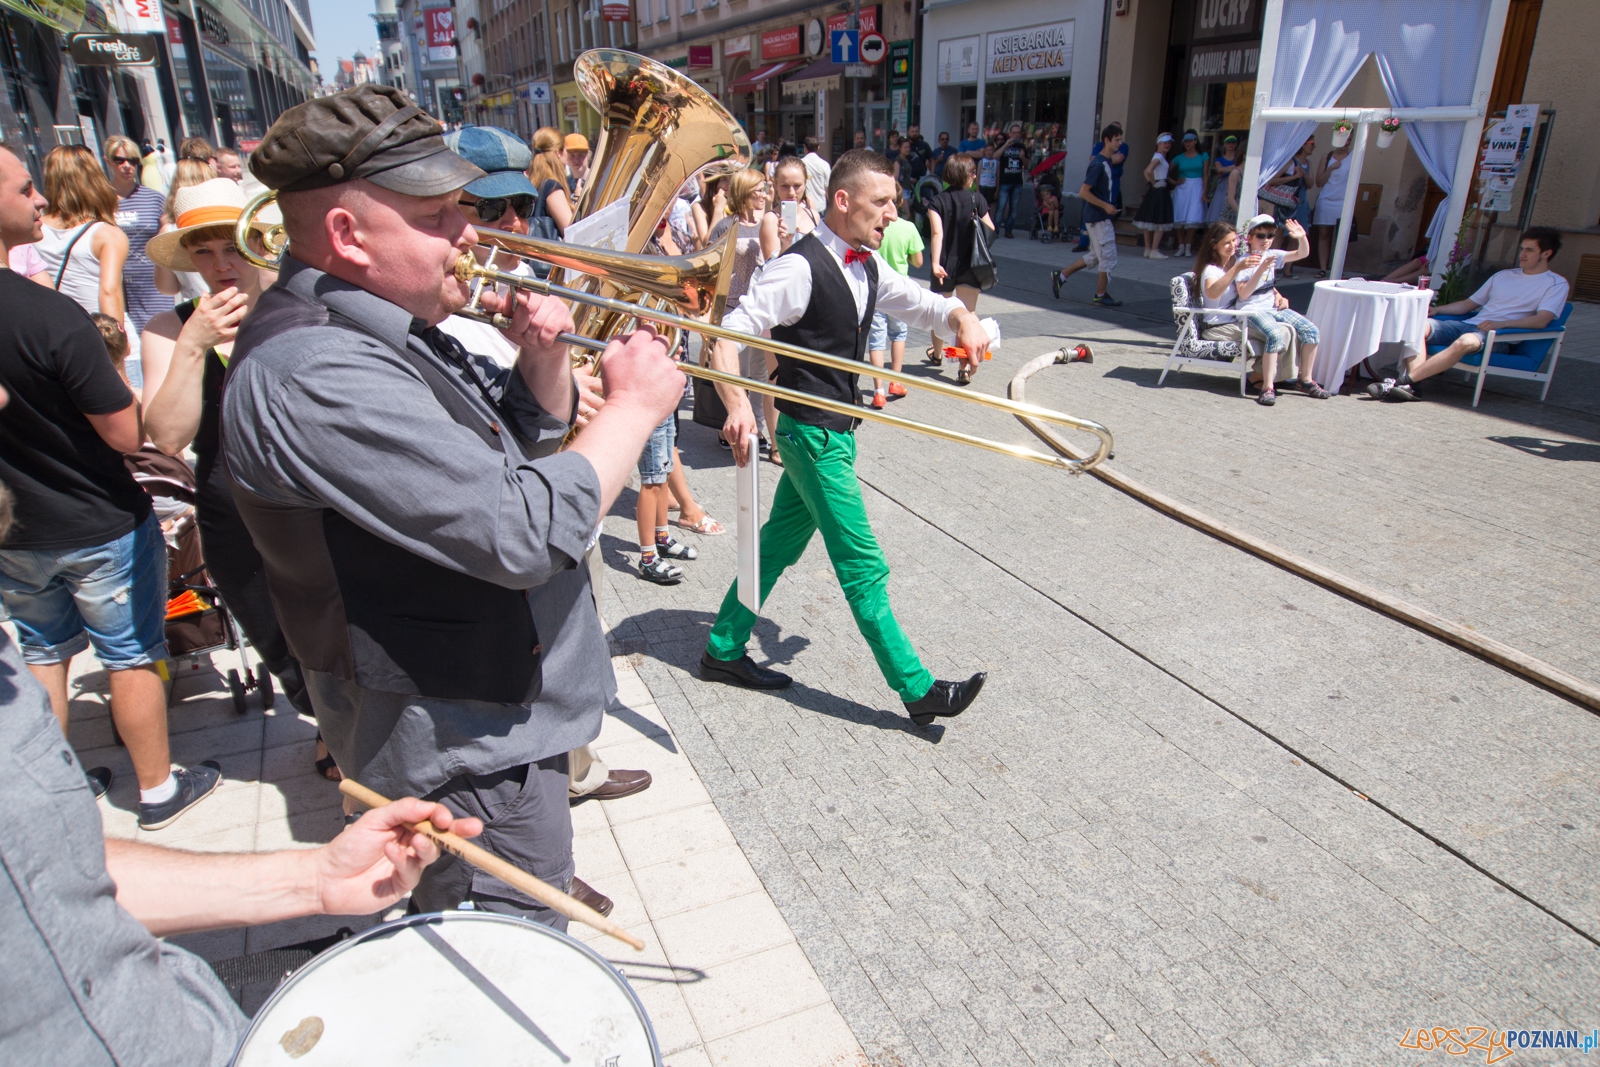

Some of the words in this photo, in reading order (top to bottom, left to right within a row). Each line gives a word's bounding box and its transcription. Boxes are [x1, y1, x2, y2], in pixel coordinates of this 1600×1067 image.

[1200, 0, 1250, 29] LUCKY
[88, 39, 127, 52] Fresh
[994, 27, 1066, 55] KSIĘGARNIA
[992, 49, 1064, 74] MEDYCZNA
[1191, 50, 1227, 77] OBUWIE
[1228, 49, 1242, 75] NA
[1243, 48, 1260, 74] TW
[1491, 141, 1517, 150] VNM
